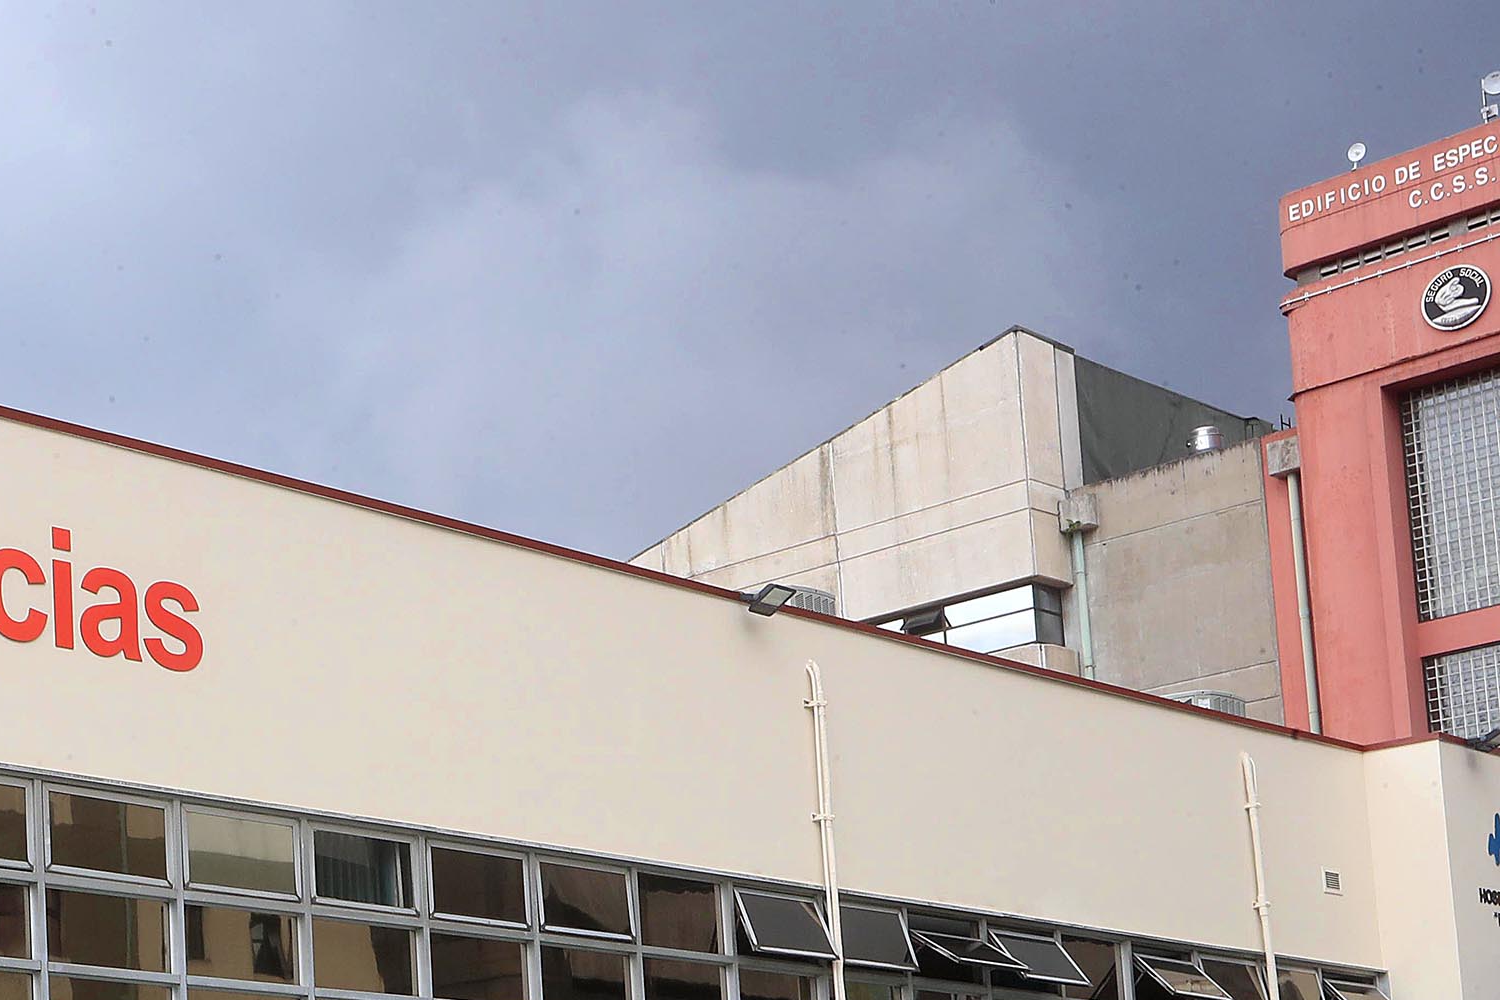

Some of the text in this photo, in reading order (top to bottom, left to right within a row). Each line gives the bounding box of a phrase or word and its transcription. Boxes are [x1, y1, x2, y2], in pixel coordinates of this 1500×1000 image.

[1288, 135, 1498, 222] EDIFICIO DE ESPEC
[1408, 166, 1496, 208] C.C.S.S.
[1425, 268, 1484, 303] SEGURO SOCIAL
